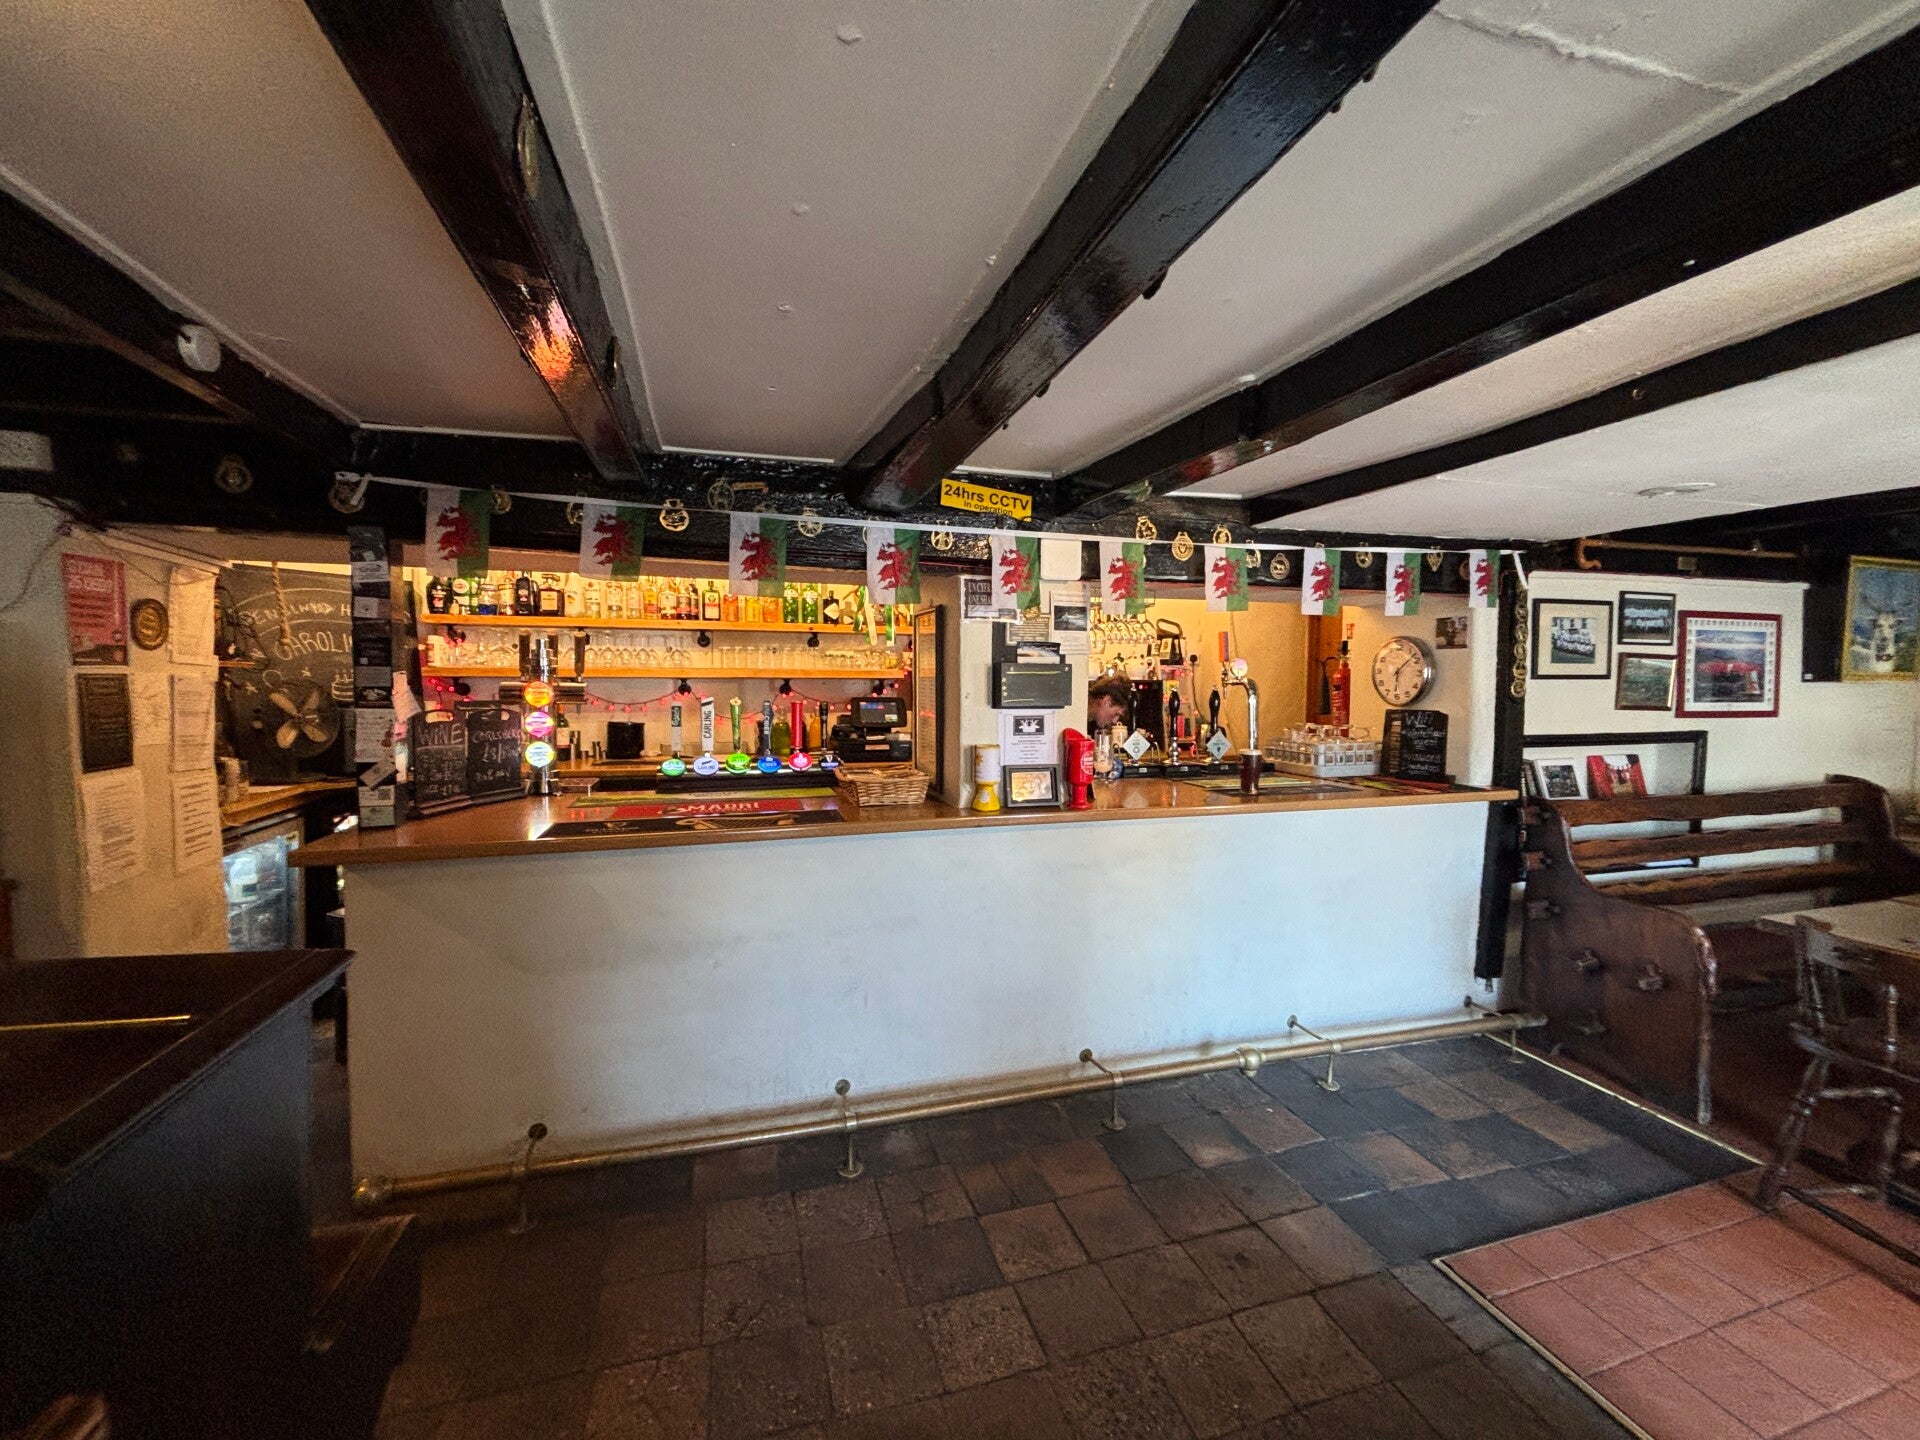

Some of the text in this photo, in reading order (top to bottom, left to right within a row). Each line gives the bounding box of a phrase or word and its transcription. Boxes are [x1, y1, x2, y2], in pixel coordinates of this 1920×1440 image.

[944, 483, 1030, 511] 24hrs CCTV
[963, 500, 1014, 516] in operation
[1416, 669, 1423, 677] 3
[1394, 693, 1401, 701] 6
[703, 710, 713, 739] CARLING
